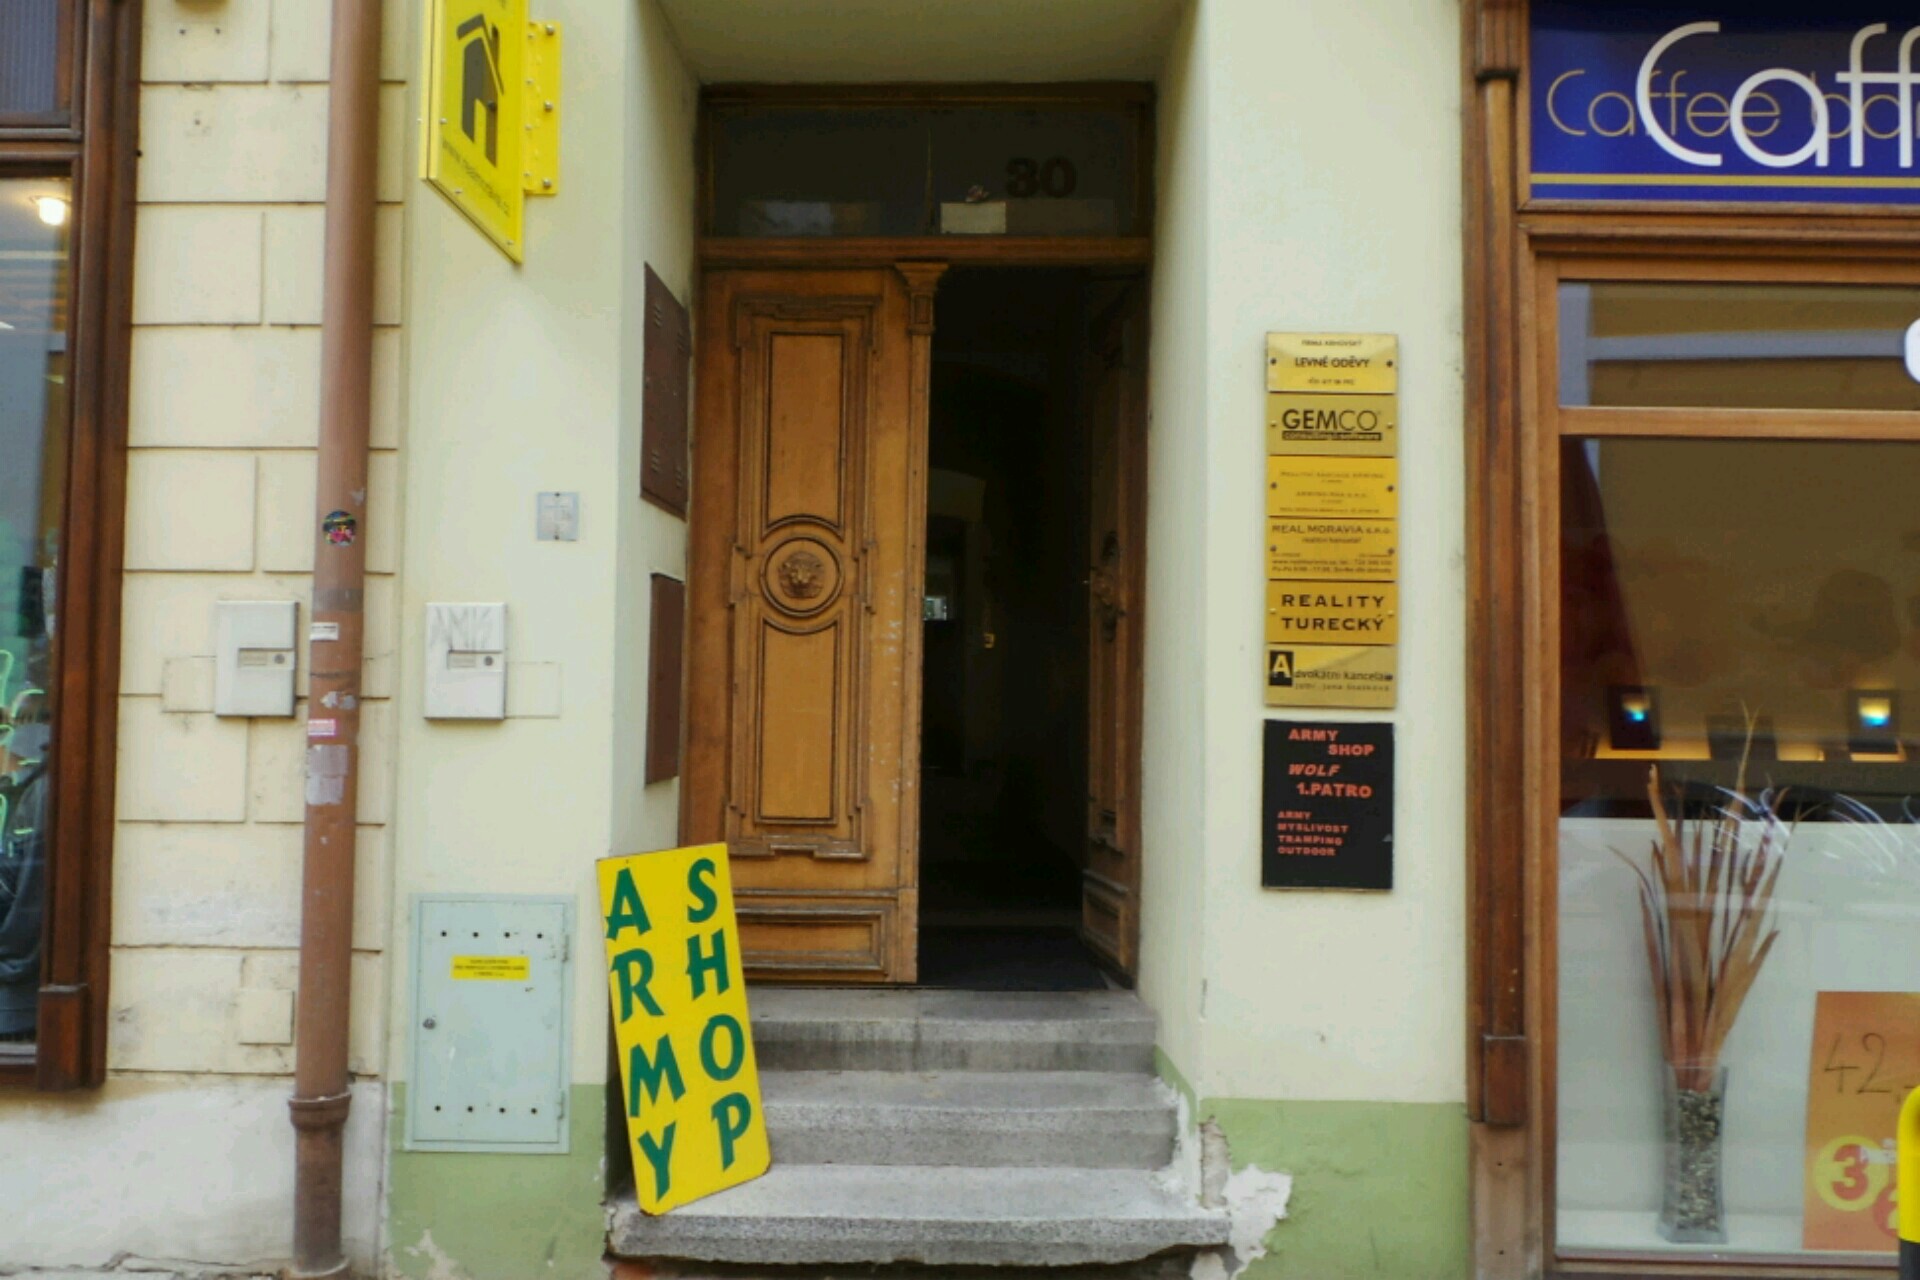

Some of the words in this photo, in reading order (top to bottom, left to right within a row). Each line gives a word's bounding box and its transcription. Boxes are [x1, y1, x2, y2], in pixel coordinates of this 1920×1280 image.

[1005, 156, 1077, 198] 30
[1295, 355, 1328, 368] LEVNÉ
[1282, 408, 1378, 431] GEMCO
[1272, 525, 1304, 534] REAL
[1307, 525, 1363, 535] MORAVIA
[1281, 593, 1385, 608] REALITY
[1281, 613, 1385, 631] TURECKÝ
[1288, 728, 1339, 741] ARMY
[1328, 744, 1375, 756] SHOP
[1288, 764, 1341, 777] WOLF
[1277, 811, 1312, 820] ARMY
[1277, 823, 1349, 833] MYSLIVOST
[1277, 835, 1343, 846] TRAMPING
[1277, 847, 1336, 856] OUTDOOR
[686, 857, 752, 1172] SHOP
[605, 868, 686, 1203] ARMY
